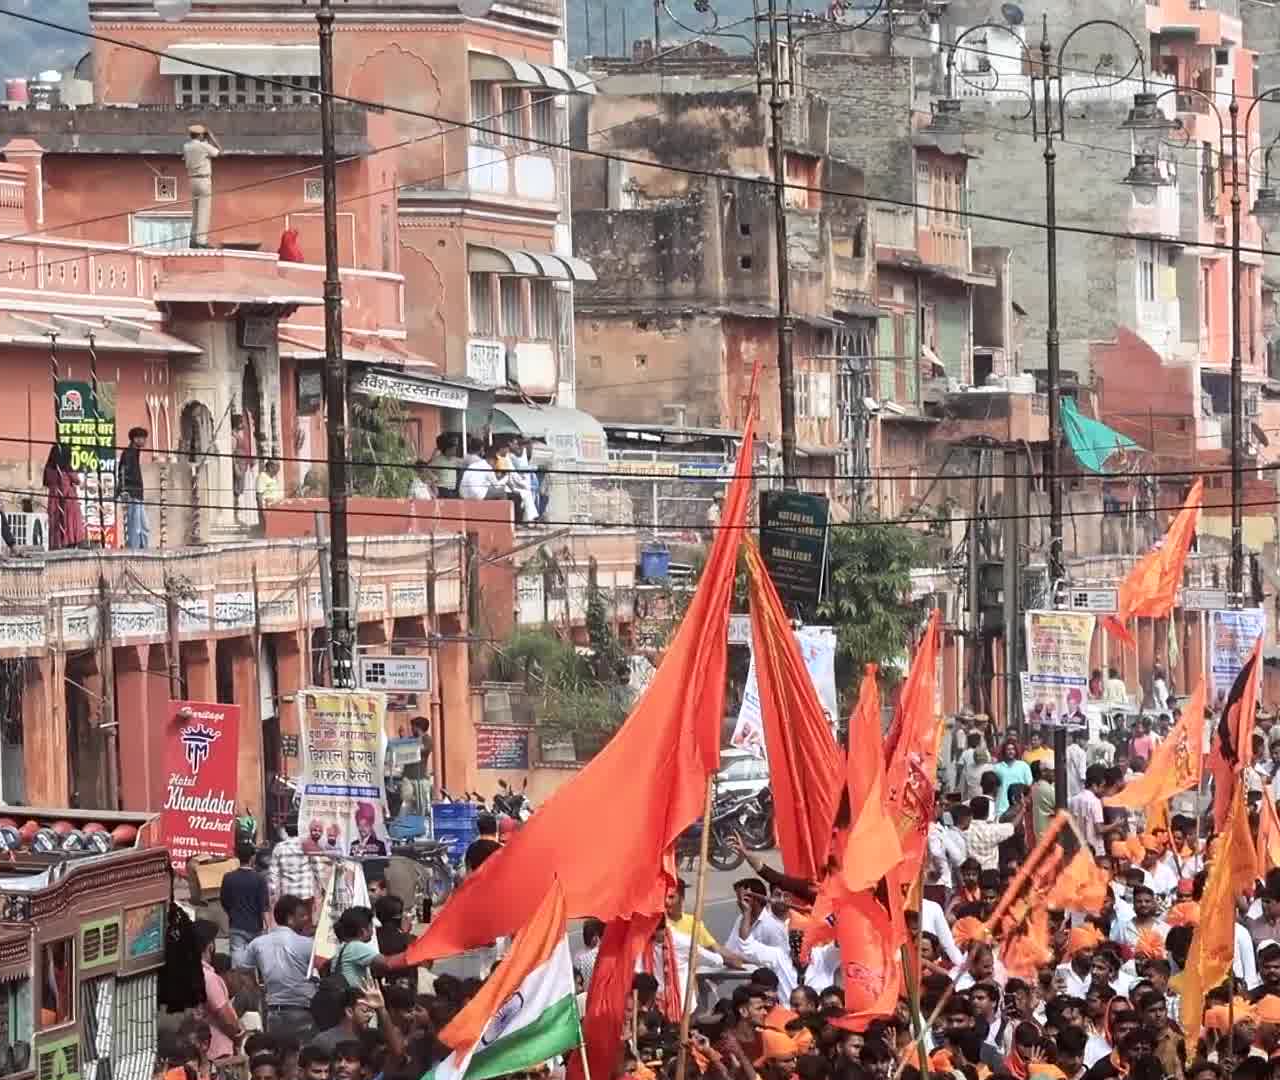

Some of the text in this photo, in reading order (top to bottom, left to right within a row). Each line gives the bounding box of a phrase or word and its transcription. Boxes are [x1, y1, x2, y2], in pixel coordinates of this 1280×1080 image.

[169, 773, 198, 787] Hotel
[164, 786, 235, 815] Khandaka
[188, 816, 233, 832] Mahal
[173, 836, 199, 847] HOTEL
